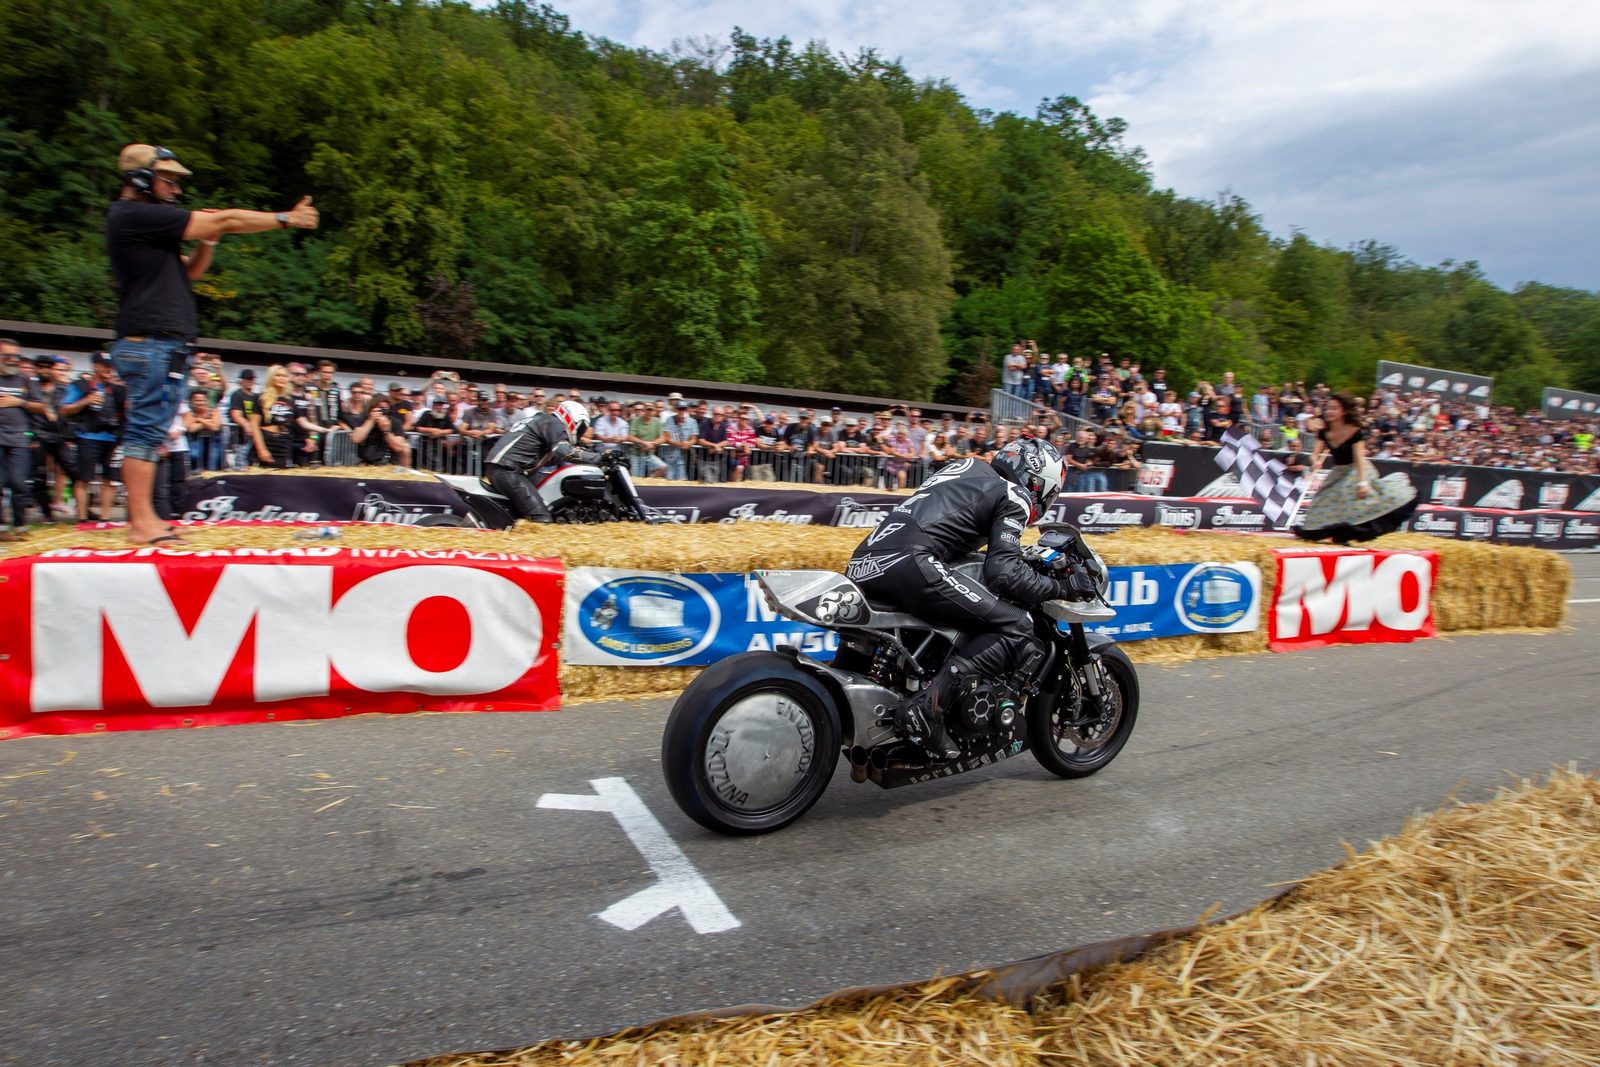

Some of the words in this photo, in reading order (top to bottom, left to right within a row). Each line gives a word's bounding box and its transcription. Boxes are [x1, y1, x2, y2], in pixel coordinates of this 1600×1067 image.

[184, 495, 321, 522] Indian
[1078, 502, 1144, 525] Indian
[1276, 553, 1433, 639] MO
[30, 562, 544, 713] MO
